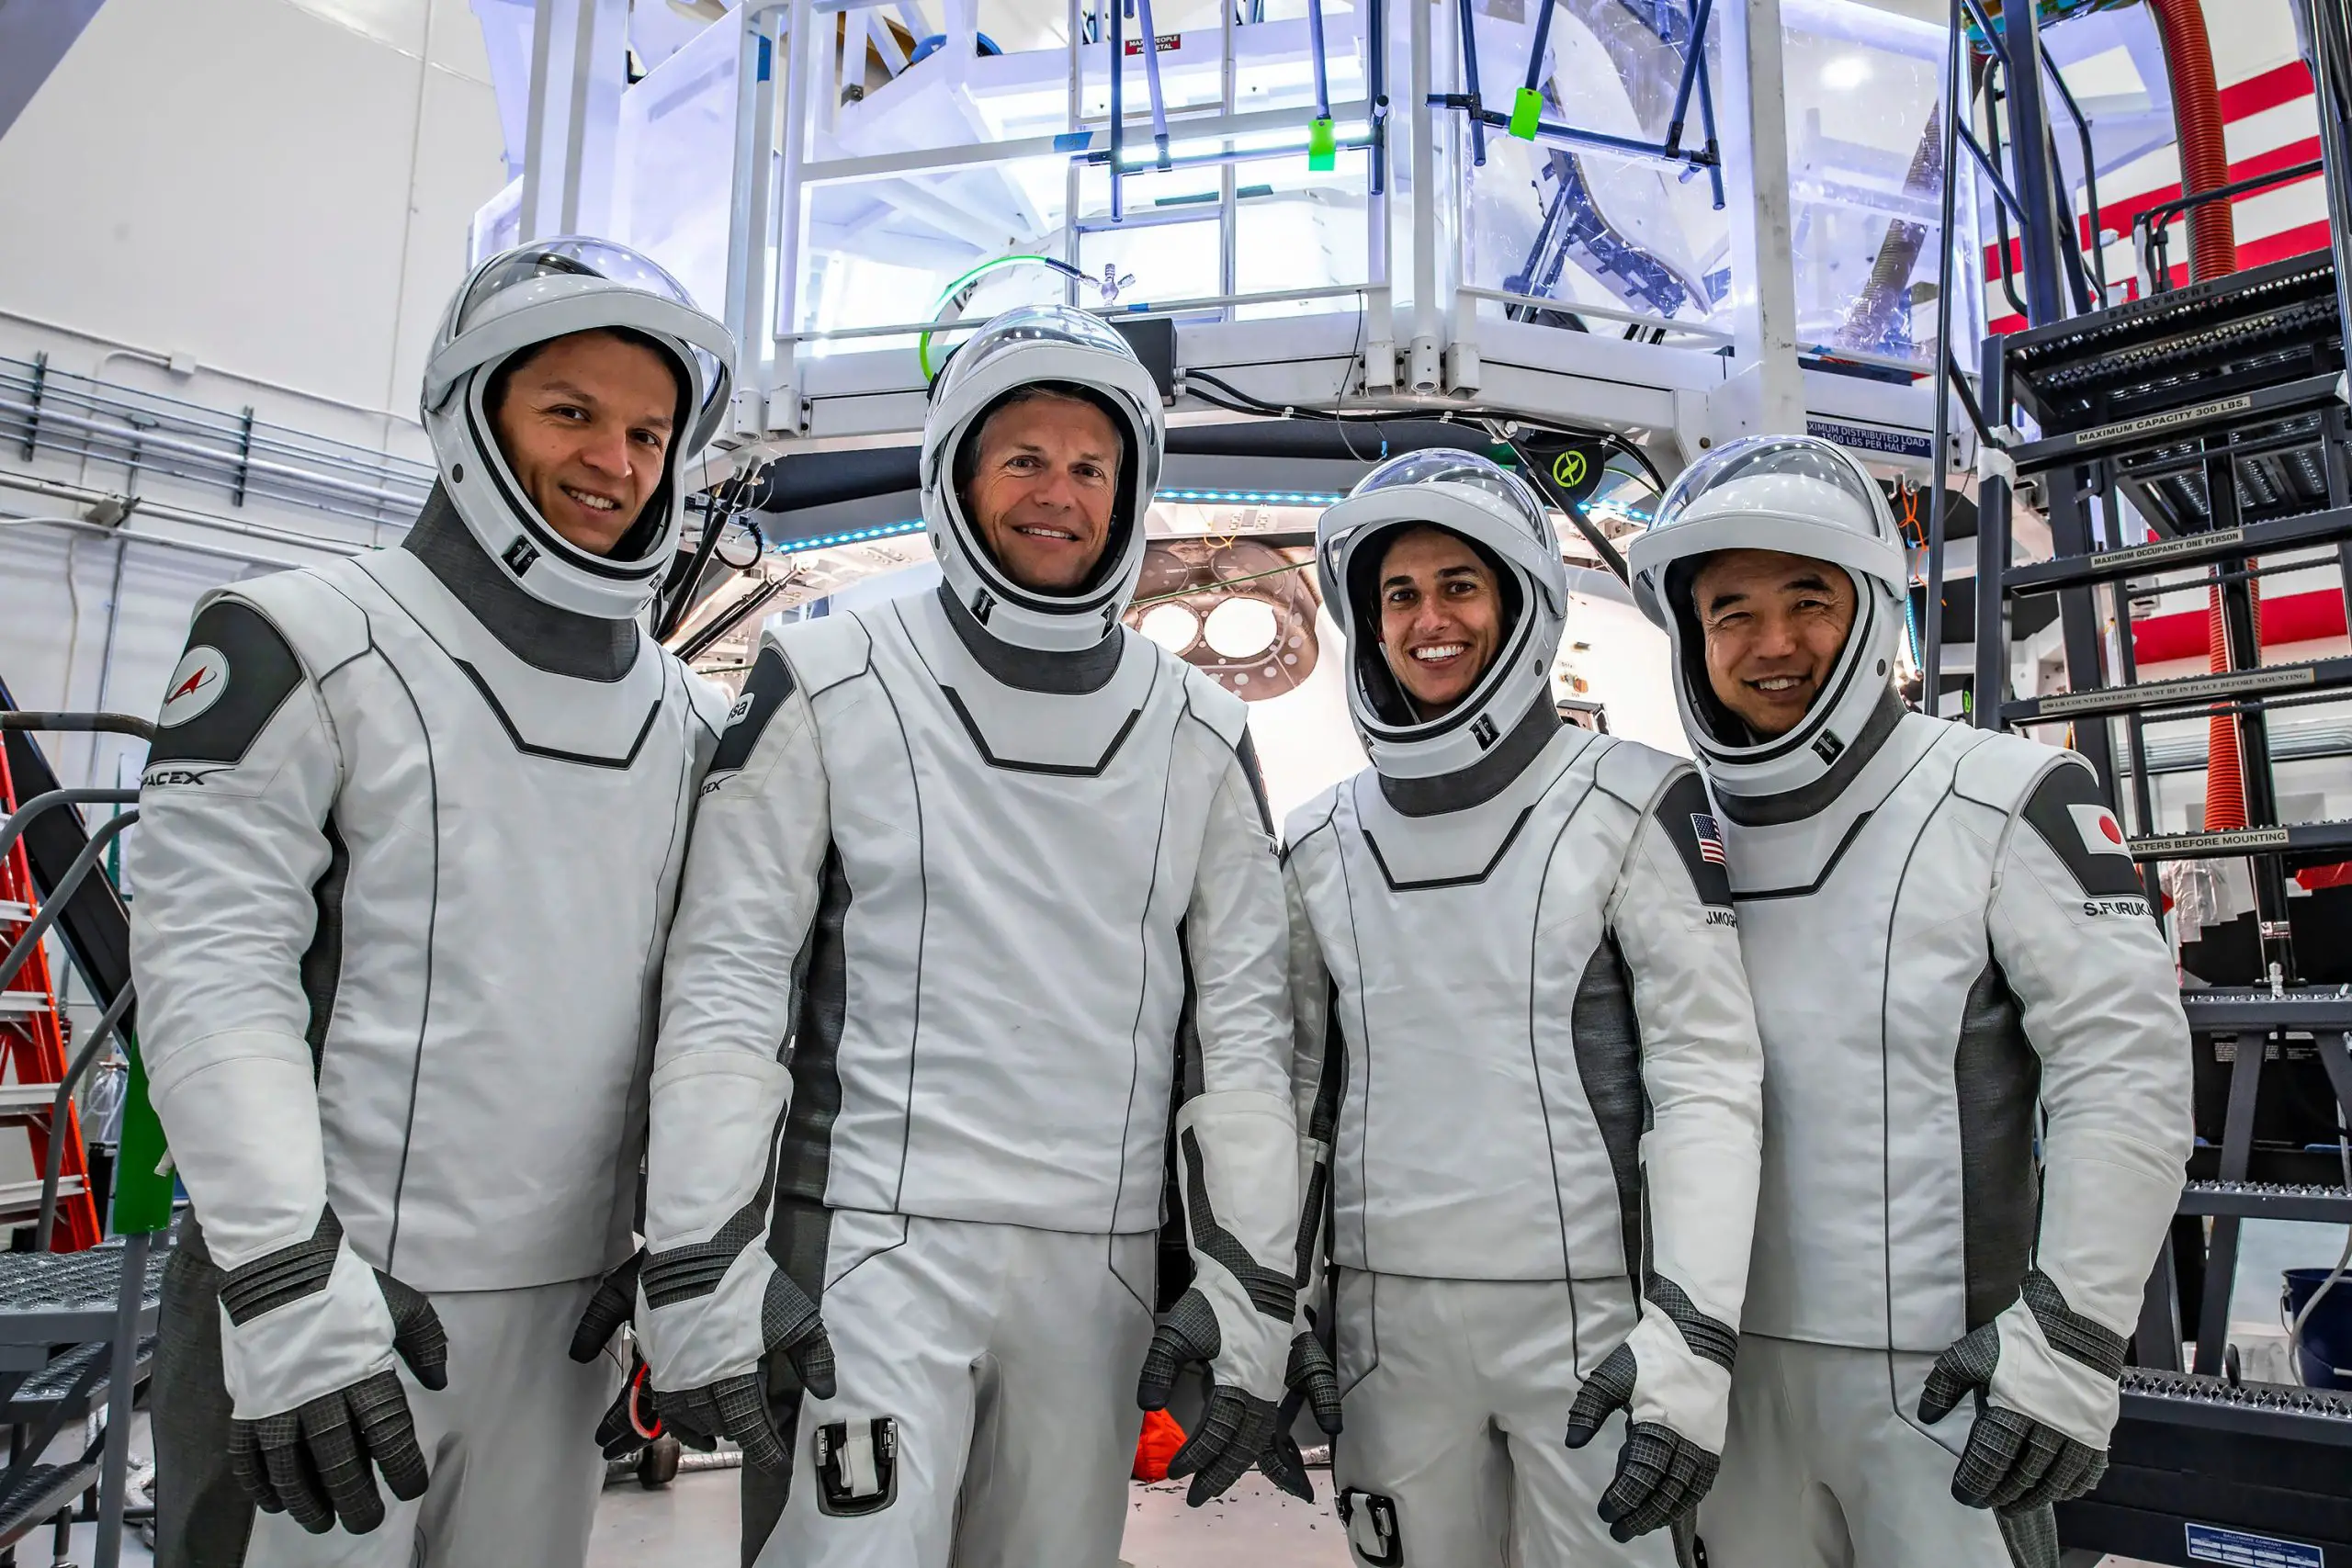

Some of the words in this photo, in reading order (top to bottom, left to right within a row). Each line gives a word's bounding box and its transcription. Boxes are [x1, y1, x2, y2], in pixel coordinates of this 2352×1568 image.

[2109, 285, 2212, 319] BALLYMORE
[2079, 424, 2133, 442] MAXIMUM
[2136, 411, 2192, 429] CAPACITY
[2196, 406, 2217, 417] 300
[2221, 400, 2247, 411] LBS.
[1807, 422, 1838, 434] XIMUM
[1841, 426, 1898, 443] DISTRIBUTED
[1901, 436, 1925, 447] LOAD
[1821, 433, 1844, 444] 1500
[1847, 436, 1862, 446] LBS
[1865, 440, 1883, 450] PER
[1884, 442, 1906, 453] HALF
[2094, 551, 2134, 566] MAXIMUM
[2136, 542, 2184, 558] OCCUPANCY
[2187, 538, 2203, 548] ONE
[2205, 533, 2239, 546] PERSON
[2179, 685, 2190, 694] IN
[2190, 682, 2218, 692] PLACE
[2220, 679, 2253, 688] BEFORE
[2257, 673, 2307, 683] MOUNTING
[727, 701, 748, 722] sa
[2128, 840, 2171, 852] ASTERS
[2175, 839, 2220, 850] BEFORE
[2222, 831, 2286, 845] MOUNTING
